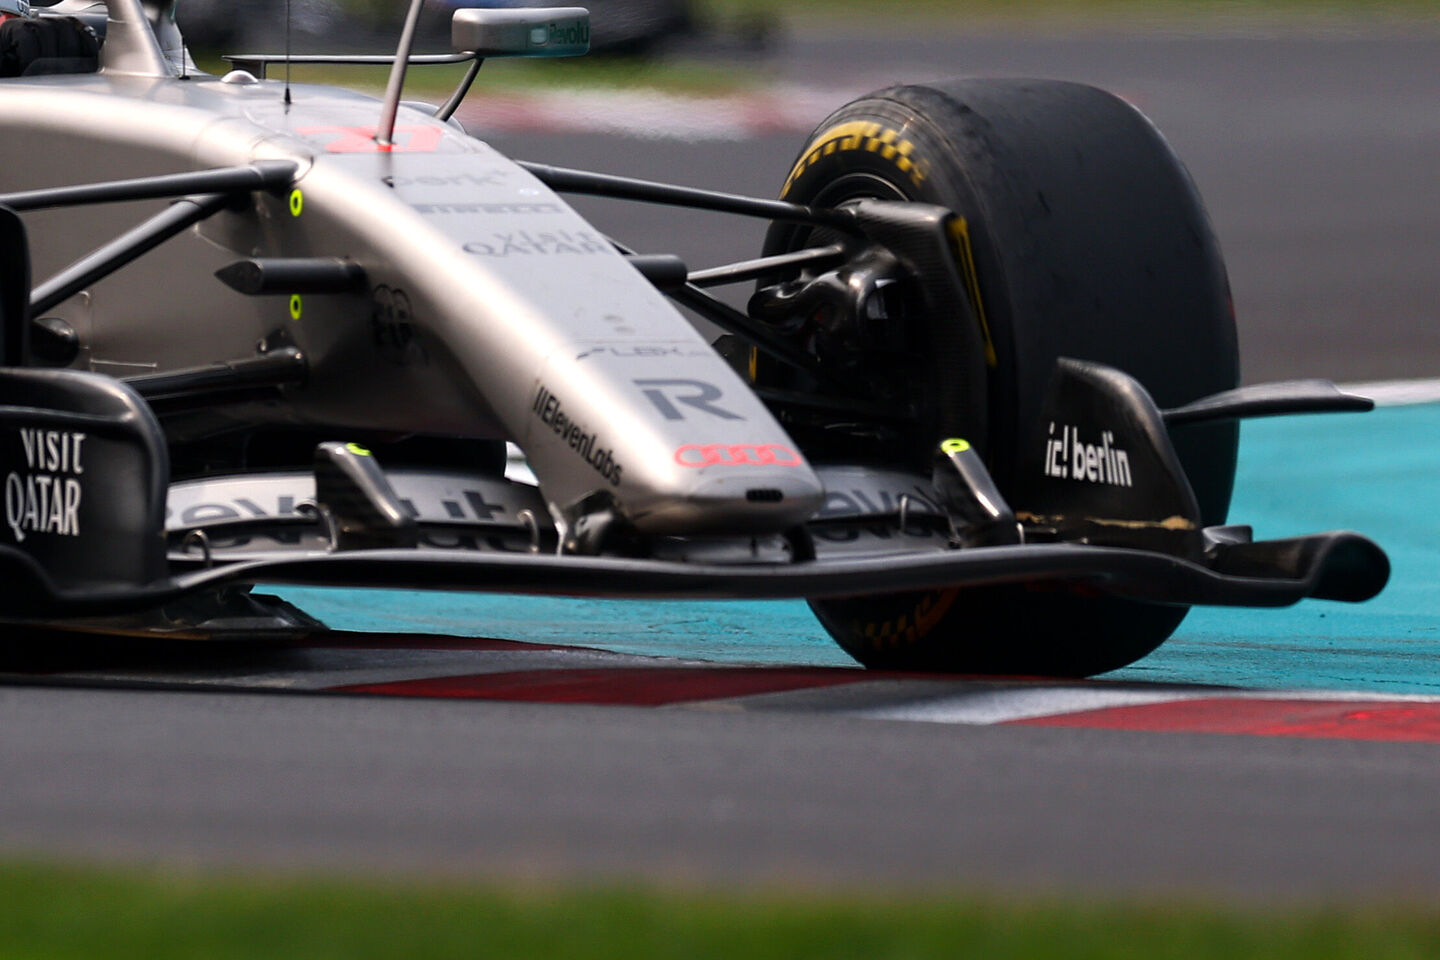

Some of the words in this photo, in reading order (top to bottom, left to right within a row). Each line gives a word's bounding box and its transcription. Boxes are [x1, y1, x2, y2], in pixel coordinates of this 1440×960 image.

[631, 378, 748, 422] R
[20, 428, 86, 474] VISIT
[1045, 422, 1068, 480] ic!
[1072, 427, 1132, 487] berlin
[6, 471, 81, 542] QATAR
